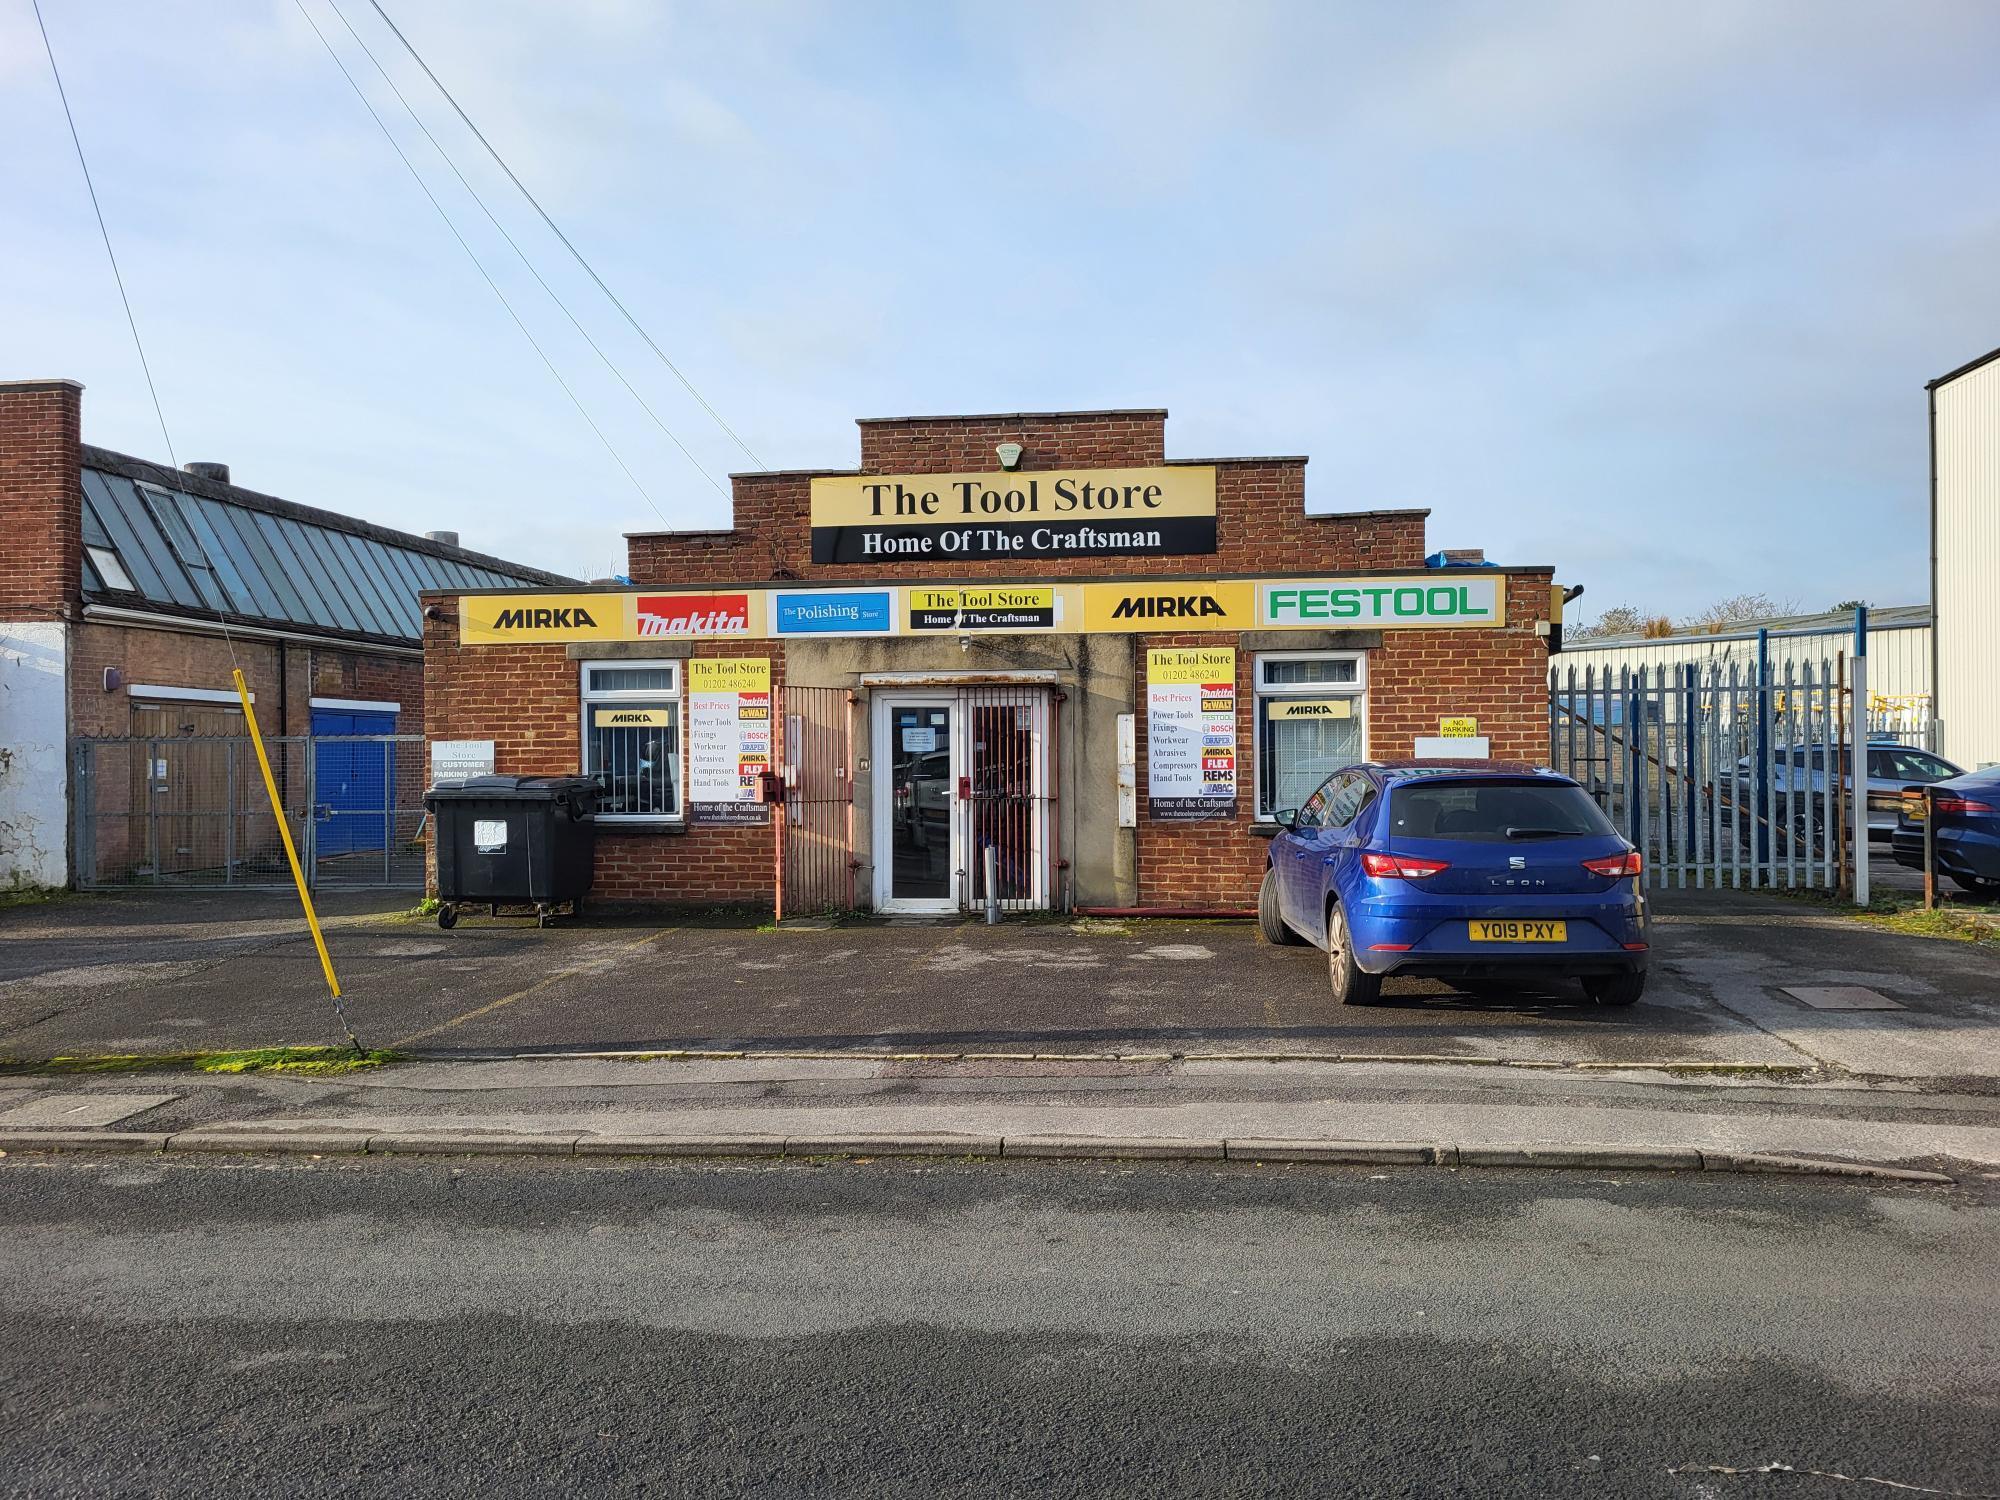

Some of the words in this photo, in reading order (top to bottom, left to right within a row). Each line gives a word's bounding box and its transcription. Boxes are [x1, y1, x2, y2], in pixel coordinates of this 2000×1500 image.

[862, 484, 939, 516] The
[953, 480, 1039, 515] Tool
[1054, 478, 1162, 511] Store
[862, 532, 933, 554] Home
[940, 529, 975, 551] Of
[977, 529, 1024, 551] The
[1030, 527, 1161, 549] Craftsman
[924, 593, 954, 607] The
[960, 592, 992, 607] Tool
[997, 591, 1040, 606] Store
[1269, 586, 1488, 619] FESTOOL
[783, 608, 796, 616] The
[797, 604, 859, 620] Polishing
[862, 610, 879, 618] Store
[1111, 595, 1227, 619] MIRKA
[492, 607, 598, 629] MIRKA
[924, 614, 952, 624] Home
[968, 613, 987, 623] The
[989, 613, 1040, 623] Craftsman
[1152, 654, 1173, 665] The
[1176, 653, 1199, 665] Tool
[1202, 652, 1231, 665] Store
[693, 663, 713, 675] The
[715, 663, 737, 675] Tool
[740, 662, 767, 674] Store
[1163, 671, 1188, 680] 01202
[1189, 670, 1220, 680] 486240
[703, 679, 726, 689] 01202
[728, 678, 756, 688] 486240
[1152, 693, 1168, 702] Best
[1170, 693, 1192, 702] Prices
[693, 701, 708, 710] Best
[709, 701, 730, 710] Prices
[1286, 704, 1333, 715] MIRKA
[610, 713, 653, 723] MIRKA
[1153, 711, 1174, 720] Power
[1176, 710, 1194, 719] Tools
[693, 718, 714, 727] Power
[716, 718, 732, 727] Tools
[1153, 723, 1178, 734] Fixings
[1210, 724, 1234, 732] BOSCH
[693, 730, 717, 741] Fixings
[747, 732, 768, 740] BOSCH
[1153, 736, 1189, 745] Workwear
[1205, 737, 1231, 745] DRAPER
[693, 742, 727, 751] Workwear
[742, 743, 766, 751] DRAPER
[452, 751, 476, 759] Store
[1153, 748, 1187, 757] Abrasives
[1203, 748, 1232, 757] MIRKA
[693, 754, 725, 763] Abrasives
[1153, 761, 1198, 772] Compressors
[1207, 759, 1229, 769] FLEX
[693, 766, 735, 776] Compressors
[744, 765, 763, 774] FLEX
[1153, 774, 1172, 782] Hand
[1174, 773, 1192, 782] Tools
[1203, 770, 1233, 782] REMS
[693, 778, 712, 787] Hand
[712, 778, 729, 787] Tools
[1211, 783, 1234, 793] ABAC
[693, 802, 713, 812] Home
[714, 802, 722, 812] of
[722, 802, 733, 812] the
[734, 802, 768, 812] Craftsman
[1153, 798, 1175, 808] Home
[1176, 798, 1185, 808] of
[1185, 798, 1196, 808] the
[1197, 798, 1234, 808] Craftsman
[1481, 923, 1519, 938] YO19
[1523, 923, 1555, 939] PXY
